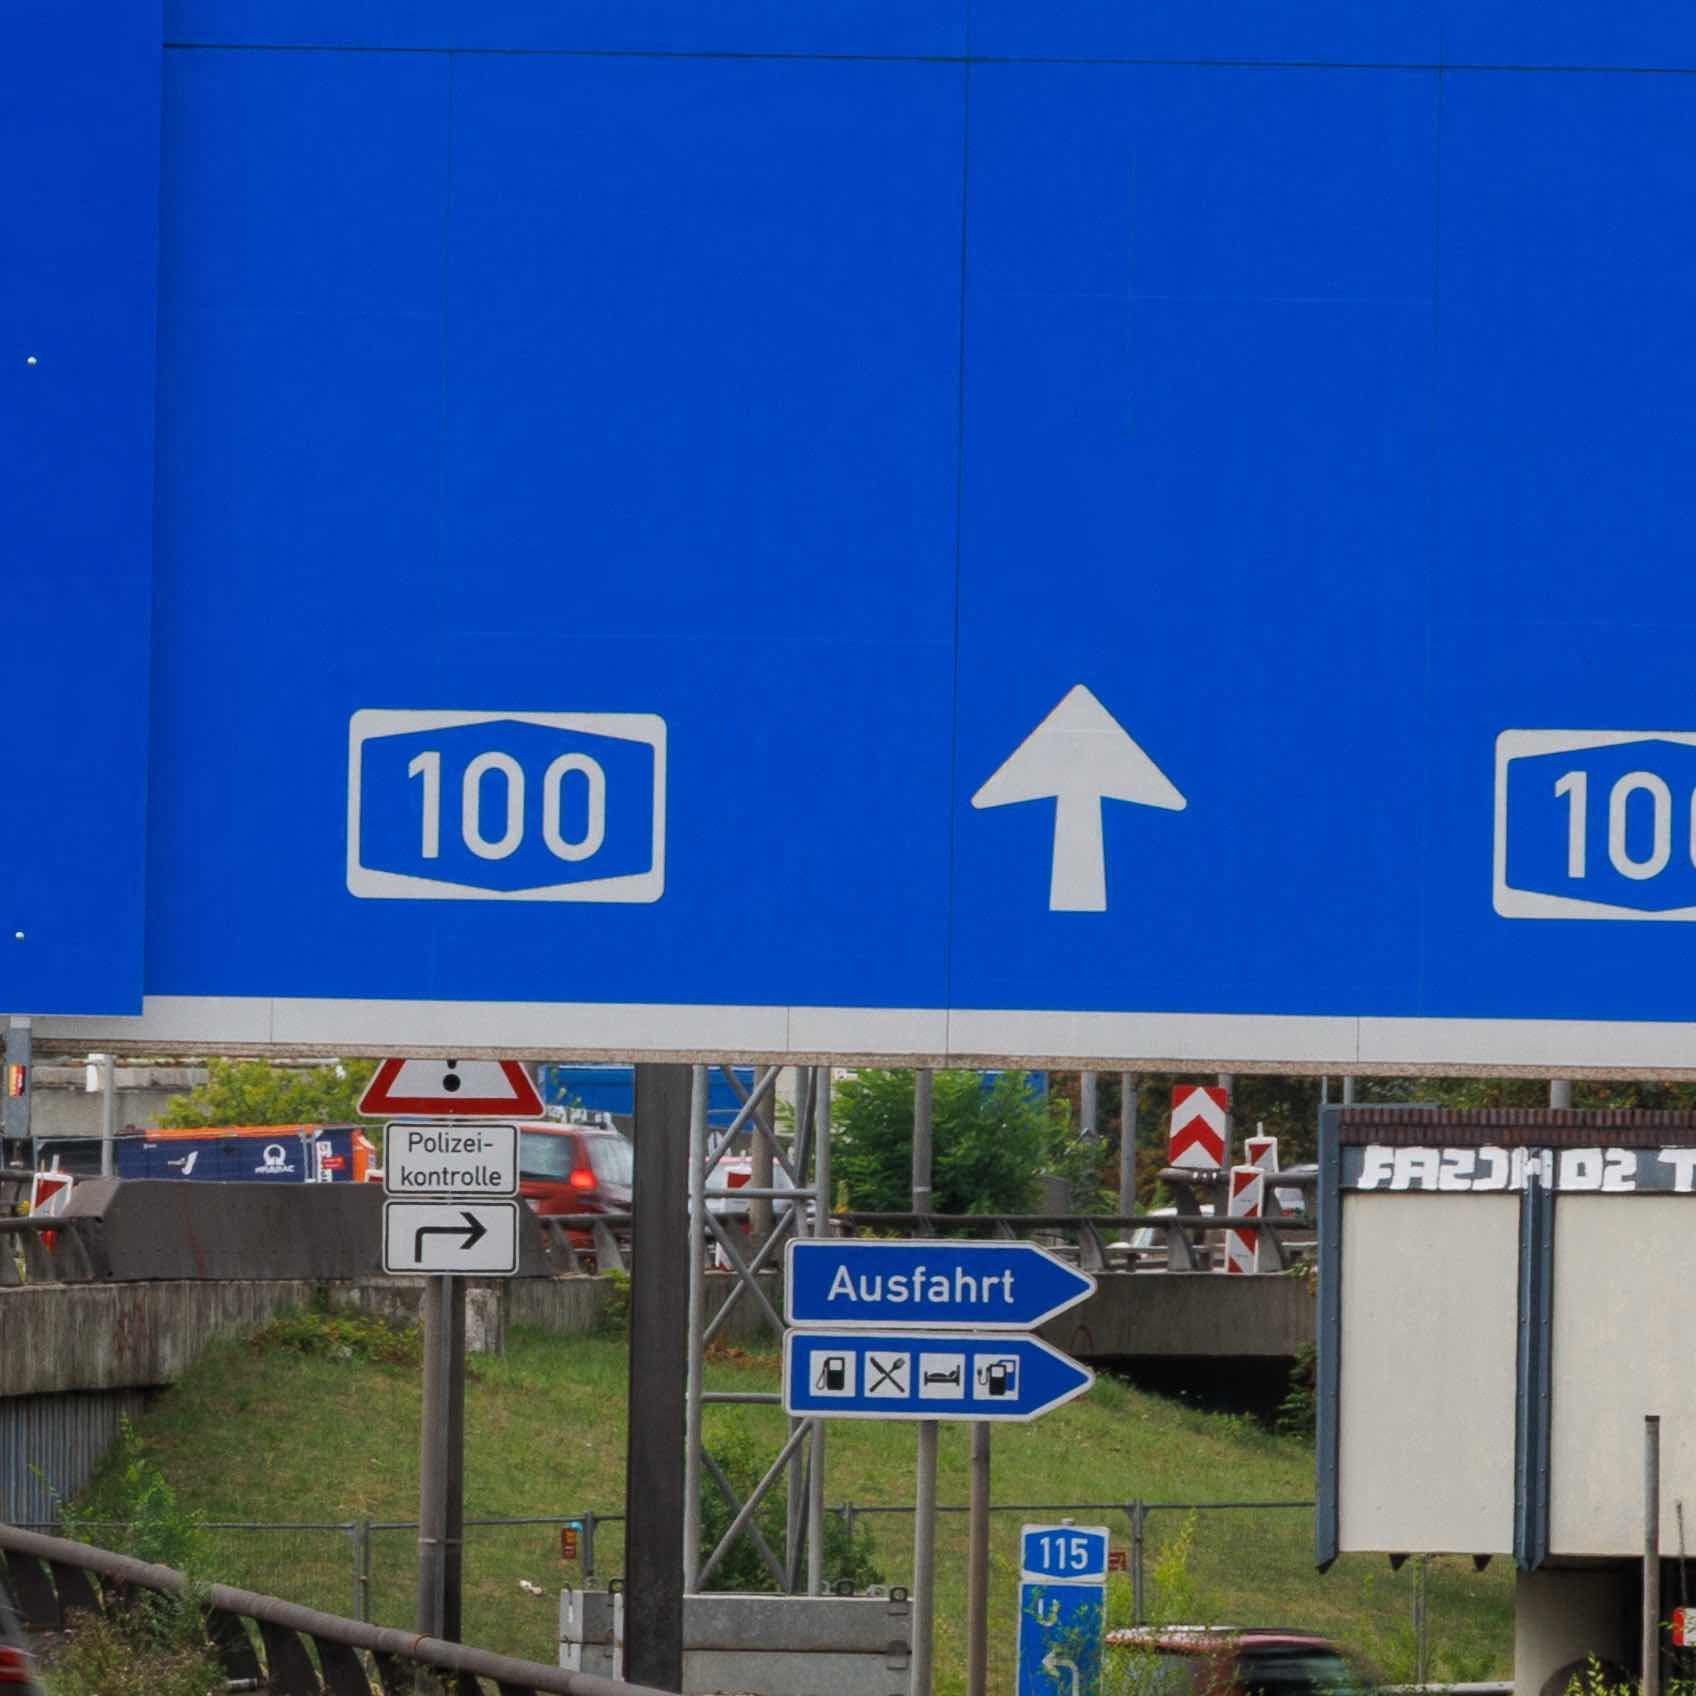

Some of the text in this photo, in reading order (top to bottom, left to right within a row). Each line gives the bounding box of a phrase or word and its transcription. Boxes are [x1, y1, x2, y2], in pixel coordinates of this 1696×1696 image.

[407, 750, 606, 862] 100
[1554, 768, 1696, 880] 10
[408, 1131, 493, 1153] Polizei-
[400, 1165, 502, 1186] kontrolle
[826, 1264, 1016, 1303] Ausfahrt
[1039, 1535, 1089, 1570] 115
